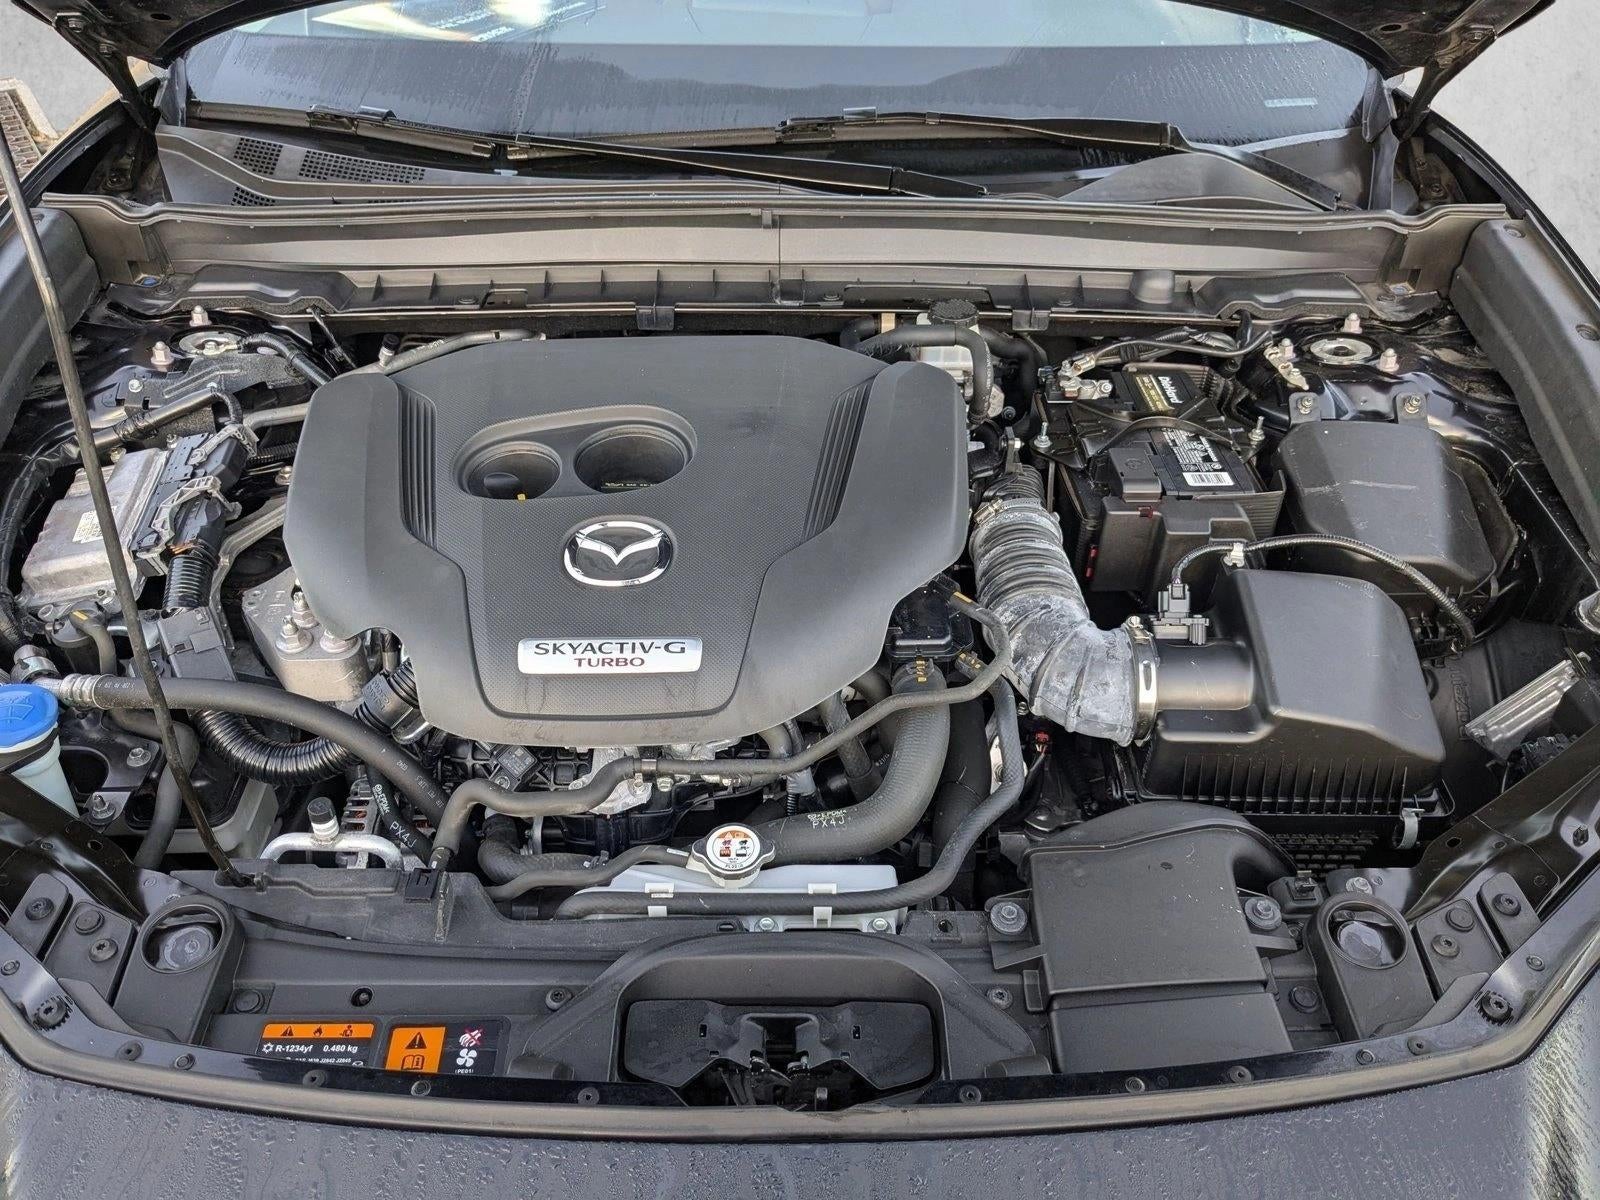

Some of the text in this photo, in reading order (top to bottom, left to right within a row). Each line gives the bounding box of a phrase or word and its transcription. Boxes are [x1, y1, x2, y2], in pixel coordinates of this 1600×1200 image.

[533, 641, 686, 656] SKYACTIV-G
[574, 656, 645, 668] TURBO
[812, 816, 845, 829] PX4J
[390, 821, 417, 848] PX4J
[275, 1044, 358, 1054] R-1234yf 0.480 kg
